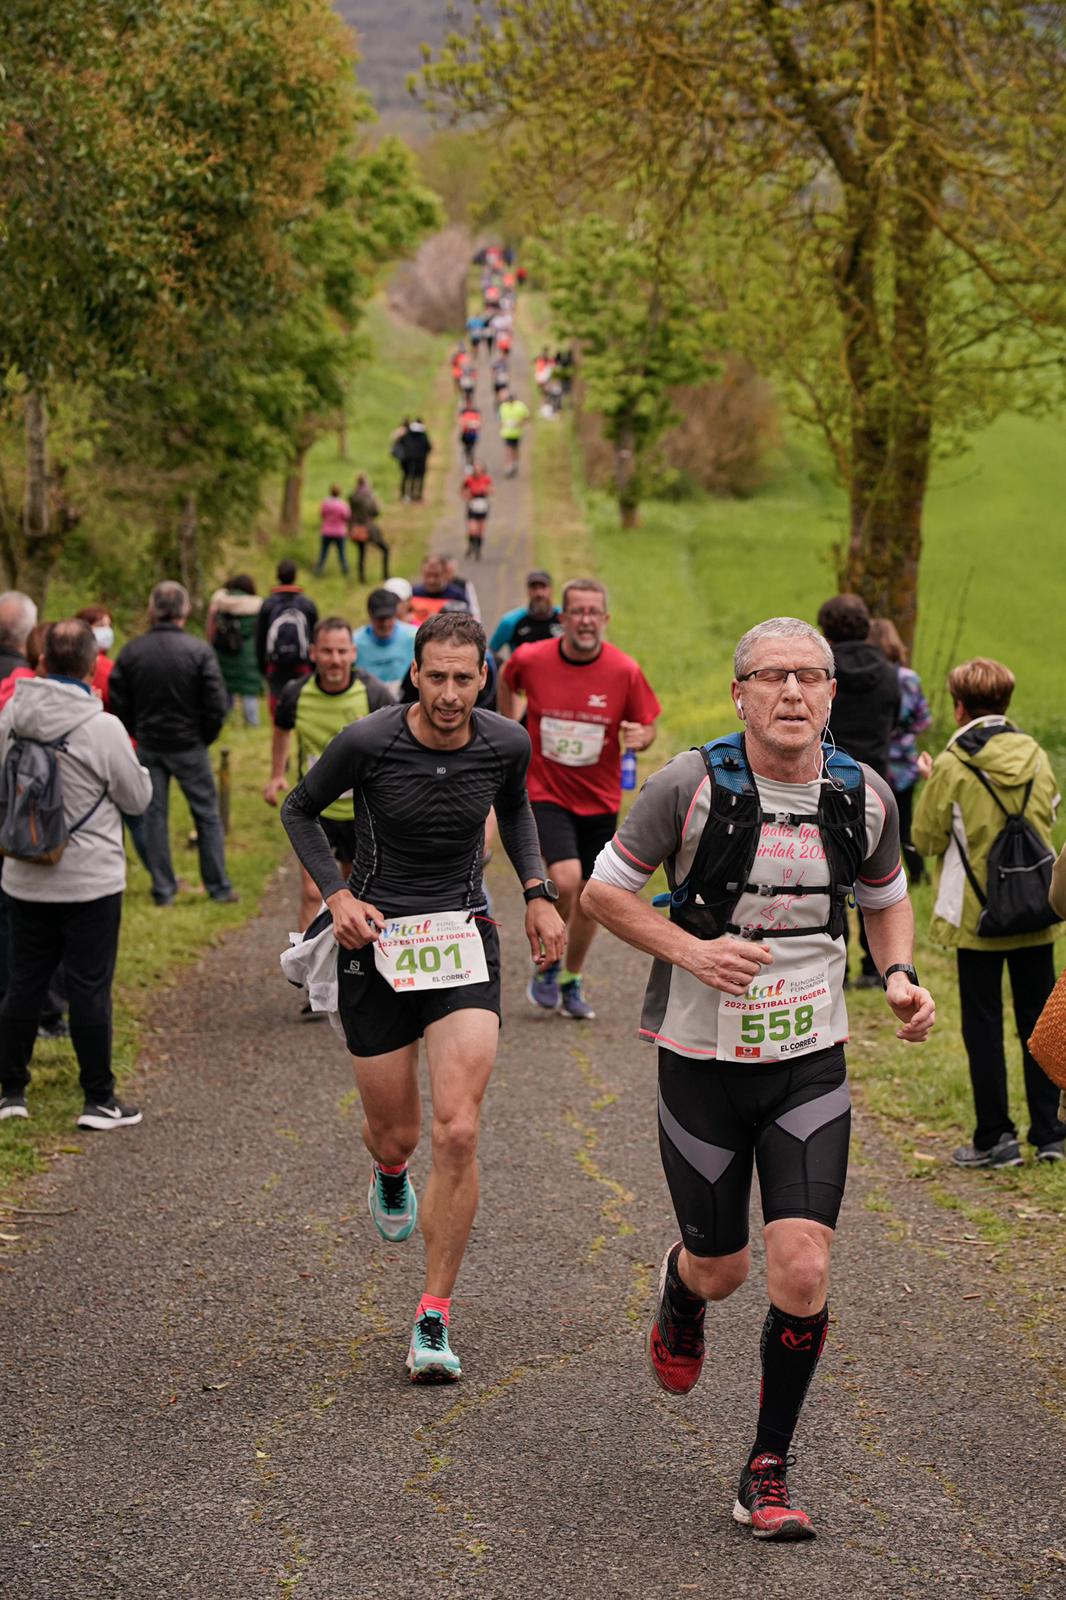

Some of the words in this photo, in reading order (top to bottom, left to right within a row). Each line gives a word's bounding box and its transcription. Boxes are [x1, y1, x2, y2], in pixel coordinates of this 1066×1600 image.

[557, 738, 583, 756] 23
[761, 822, 794, 838] baliz
[383, 919, 432, 938] Vital
[399, 935, 444, 946] ESTIBALIZ
[446, 932, 477, 941] IGOERA
[395, 943, 462, 975] 401
[441, 973, 470, 981] CORREO
[724, 1000, 747, 1010] 2022
[748, 996, 798, 1011] ESTIBALIZ
[800, 987, 827, 1002] IGOERA
[741, 1004, 814, 1045] 558
[789, 1036, 817, 1050] CORREO
